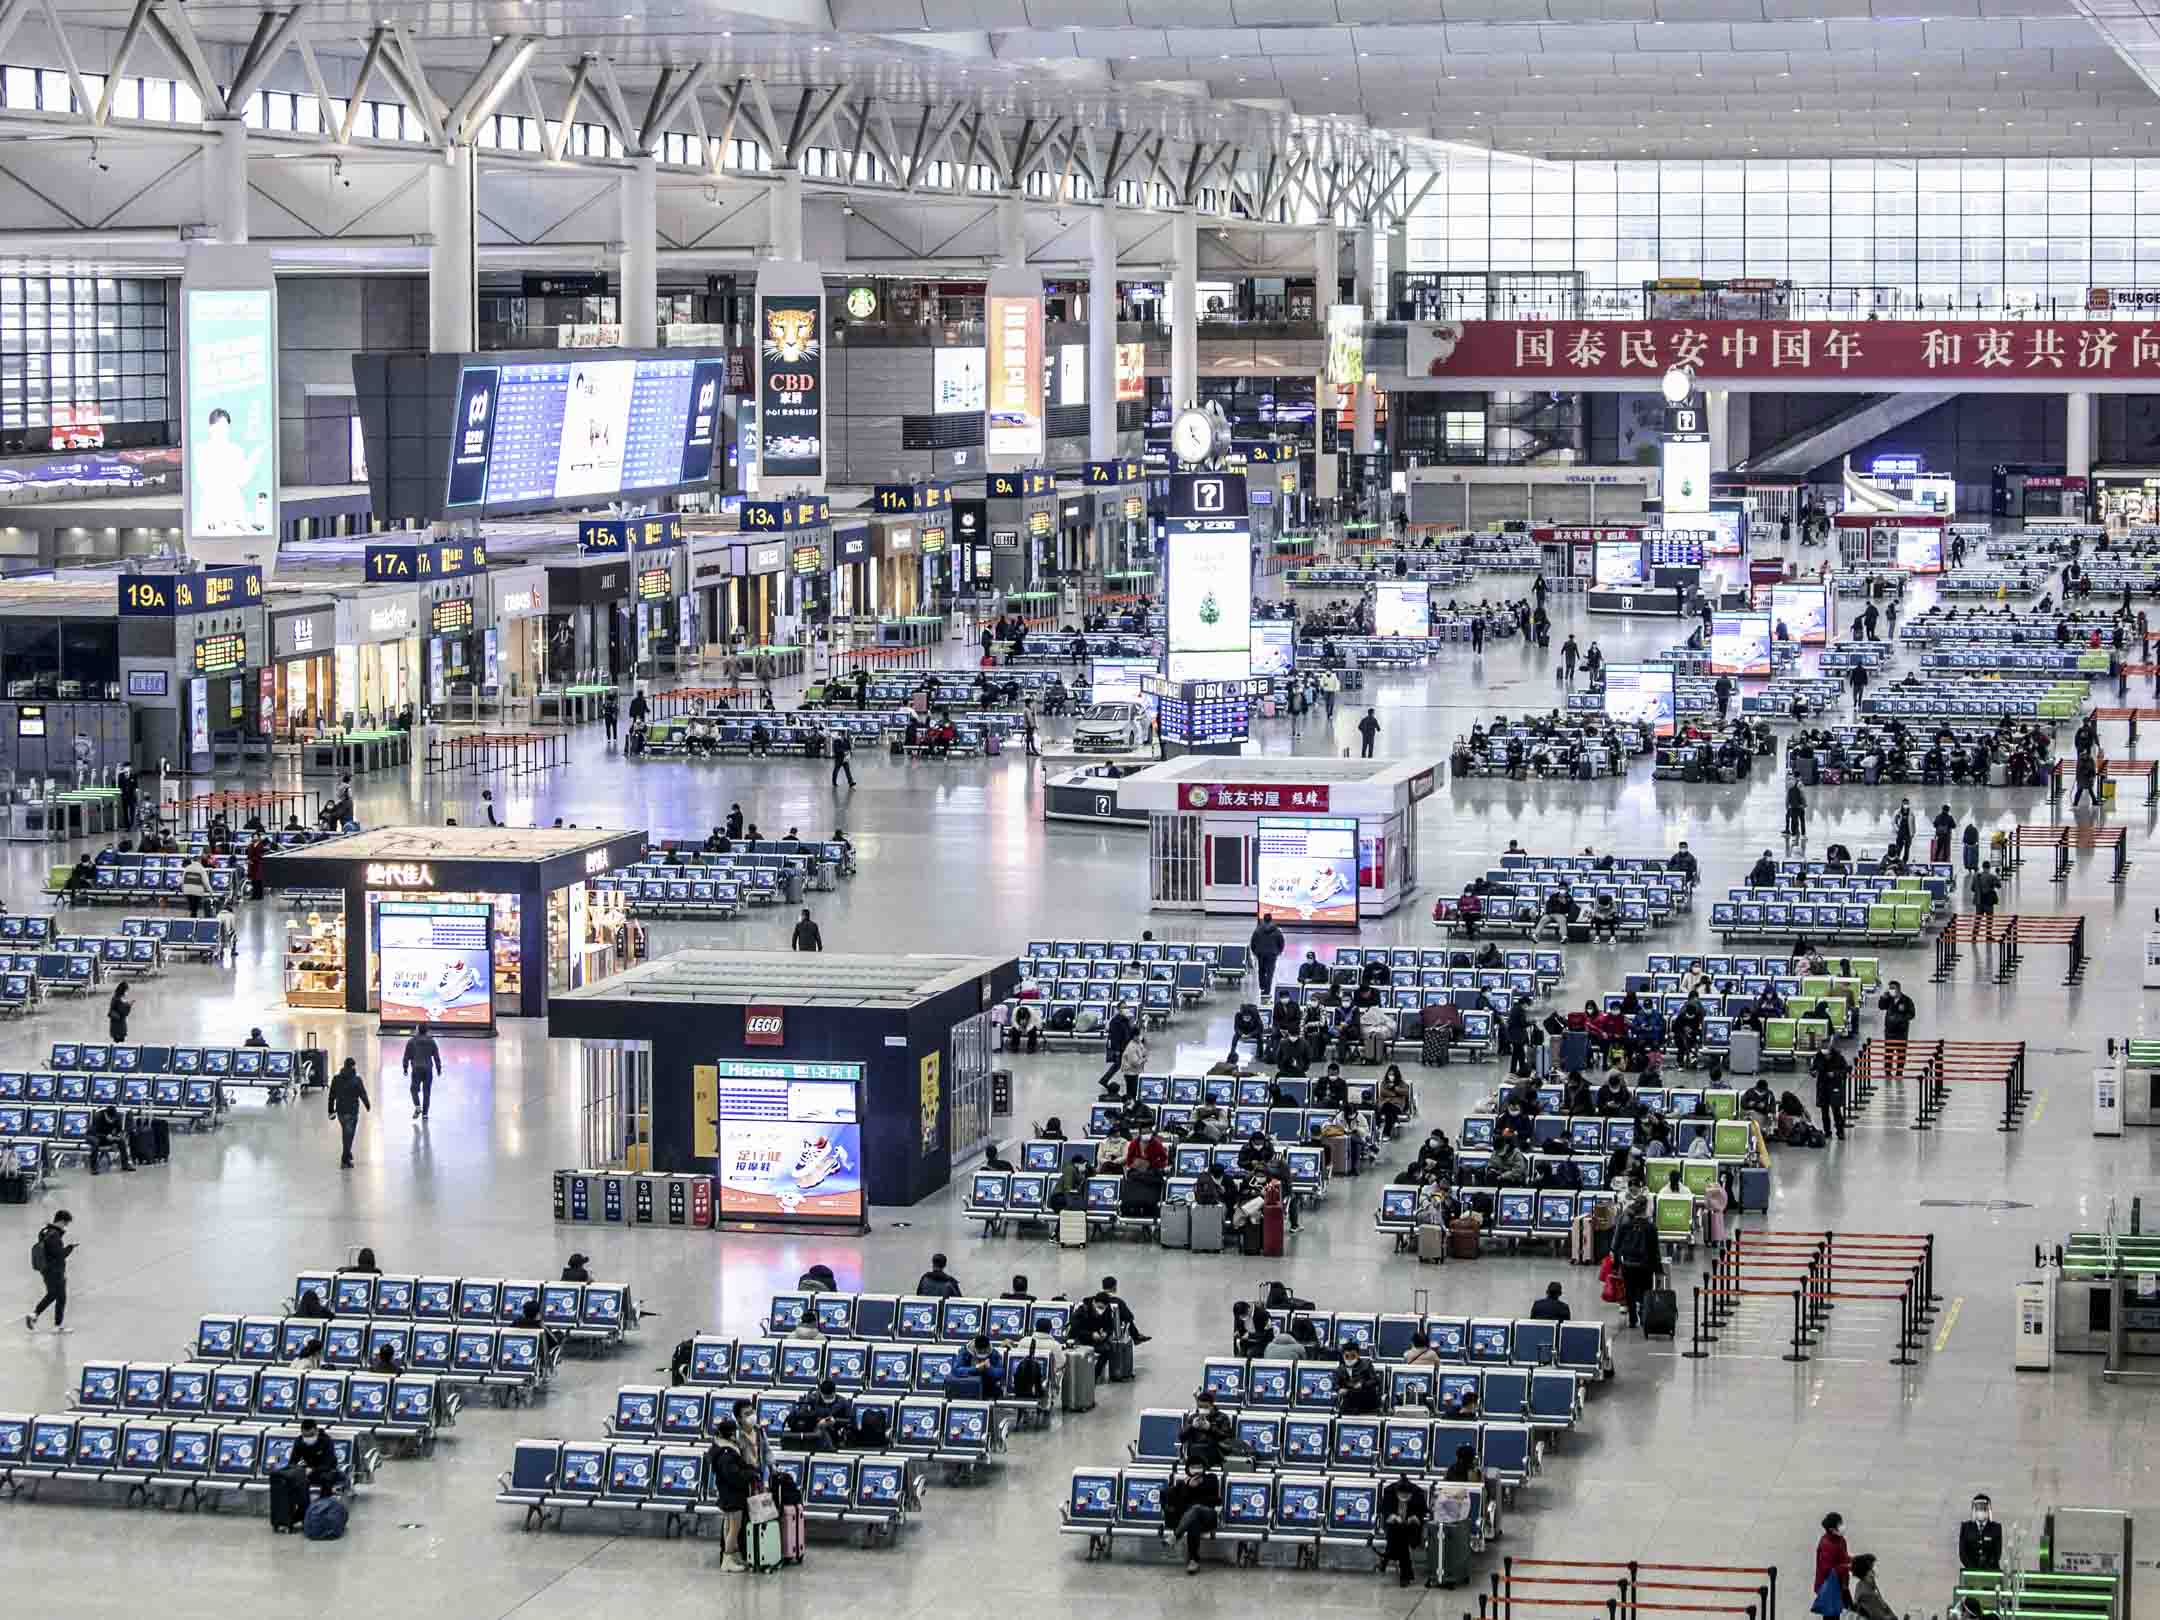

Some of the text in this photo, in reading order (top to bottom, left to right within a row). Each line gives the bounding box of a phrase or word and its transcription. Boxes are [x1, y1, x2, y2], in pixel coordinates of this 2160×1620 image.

[1515, 328, 1863, 368] 国泰民安中国年
[770, 373, 815, 391] CBD
[1091, 467, 1109, 480] 7A
[995, 479, 1013, 493] 9A
[881, 492, 906, 508] 11A
[747, 508, 775, 525] 13A
[586, 527, 618, 546] 15A
[372, 554, 409, 575] 17A
[417, 553, 432, 573] 17A
[176, 583, 193, 606] 19A
[246, 575, 261, 597] 18A
[128, 584, 166, 607] 19A
[1218, 790, 1281, 807] 旅友书屋
[748, 1016, 783, 1034] LEGO
[728, 1063, 785, 1078] Hisense
